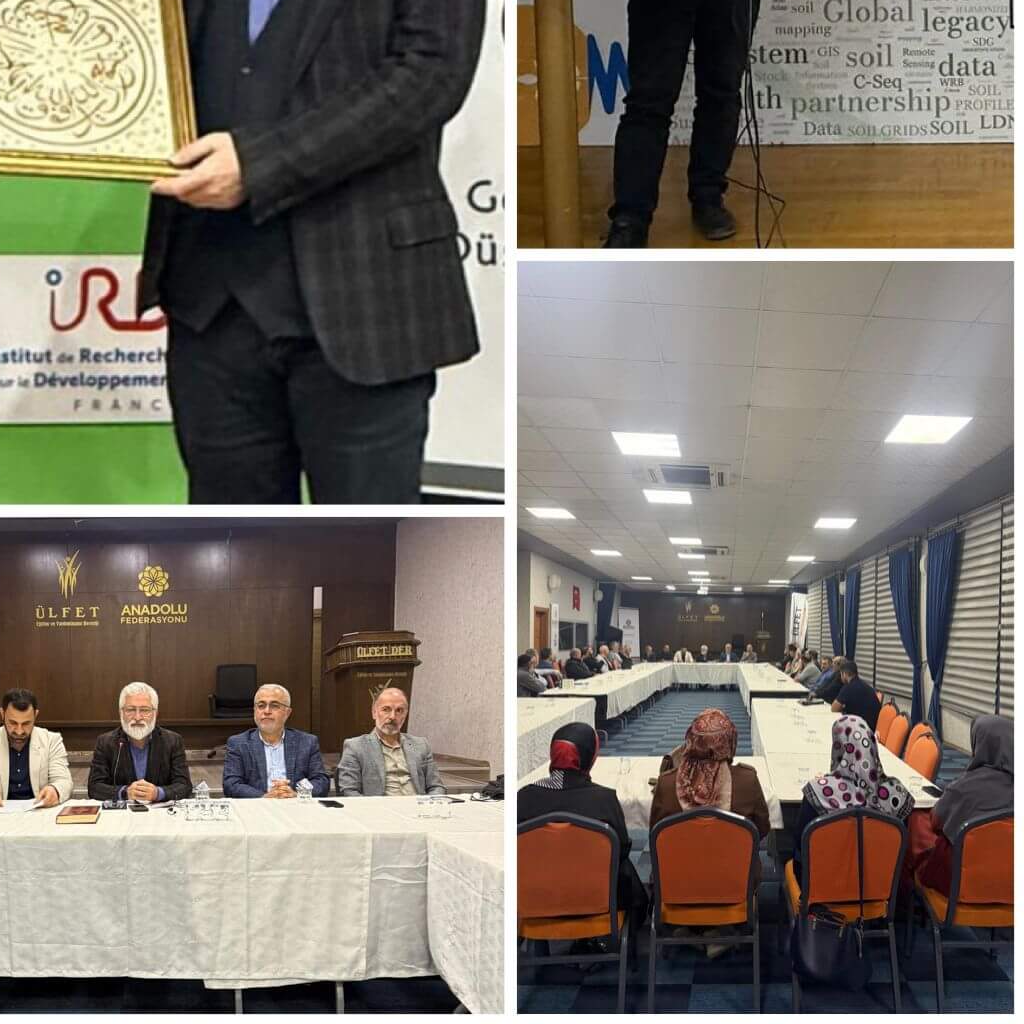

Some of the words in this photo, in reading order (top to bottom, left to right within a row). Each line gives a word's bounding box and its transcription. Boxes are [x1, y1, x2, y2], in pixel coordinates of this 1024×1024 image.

[791, 0, 814, 13] soil
[776, 23, 832, 36] mapping
[922, 7, 1009, 39] legacy
[973, 37, 994, 47] SDG
[846, 42, 893, 68] soil
[902, 47, 936, 57] Remote
[939, 53, 996, 77] data
[854, 74, 902, 93] C-Seq
[968, 84, 1001, 96] SOIL
[791, 86, 951, 121] partnership
[804, 120, 842, 136] Data
[847, 124, 926, 137] SOILGRIDS
[930, 119, 974, 135] SOIL
[57, 352, 74, 364] de
[18, 375, 31, 388] le
[36, 605, 100, 619] ÜLFET
[121, 603, 188, 616] ANADOLU
[121, 616, 188, 625] FEDERASYONU
